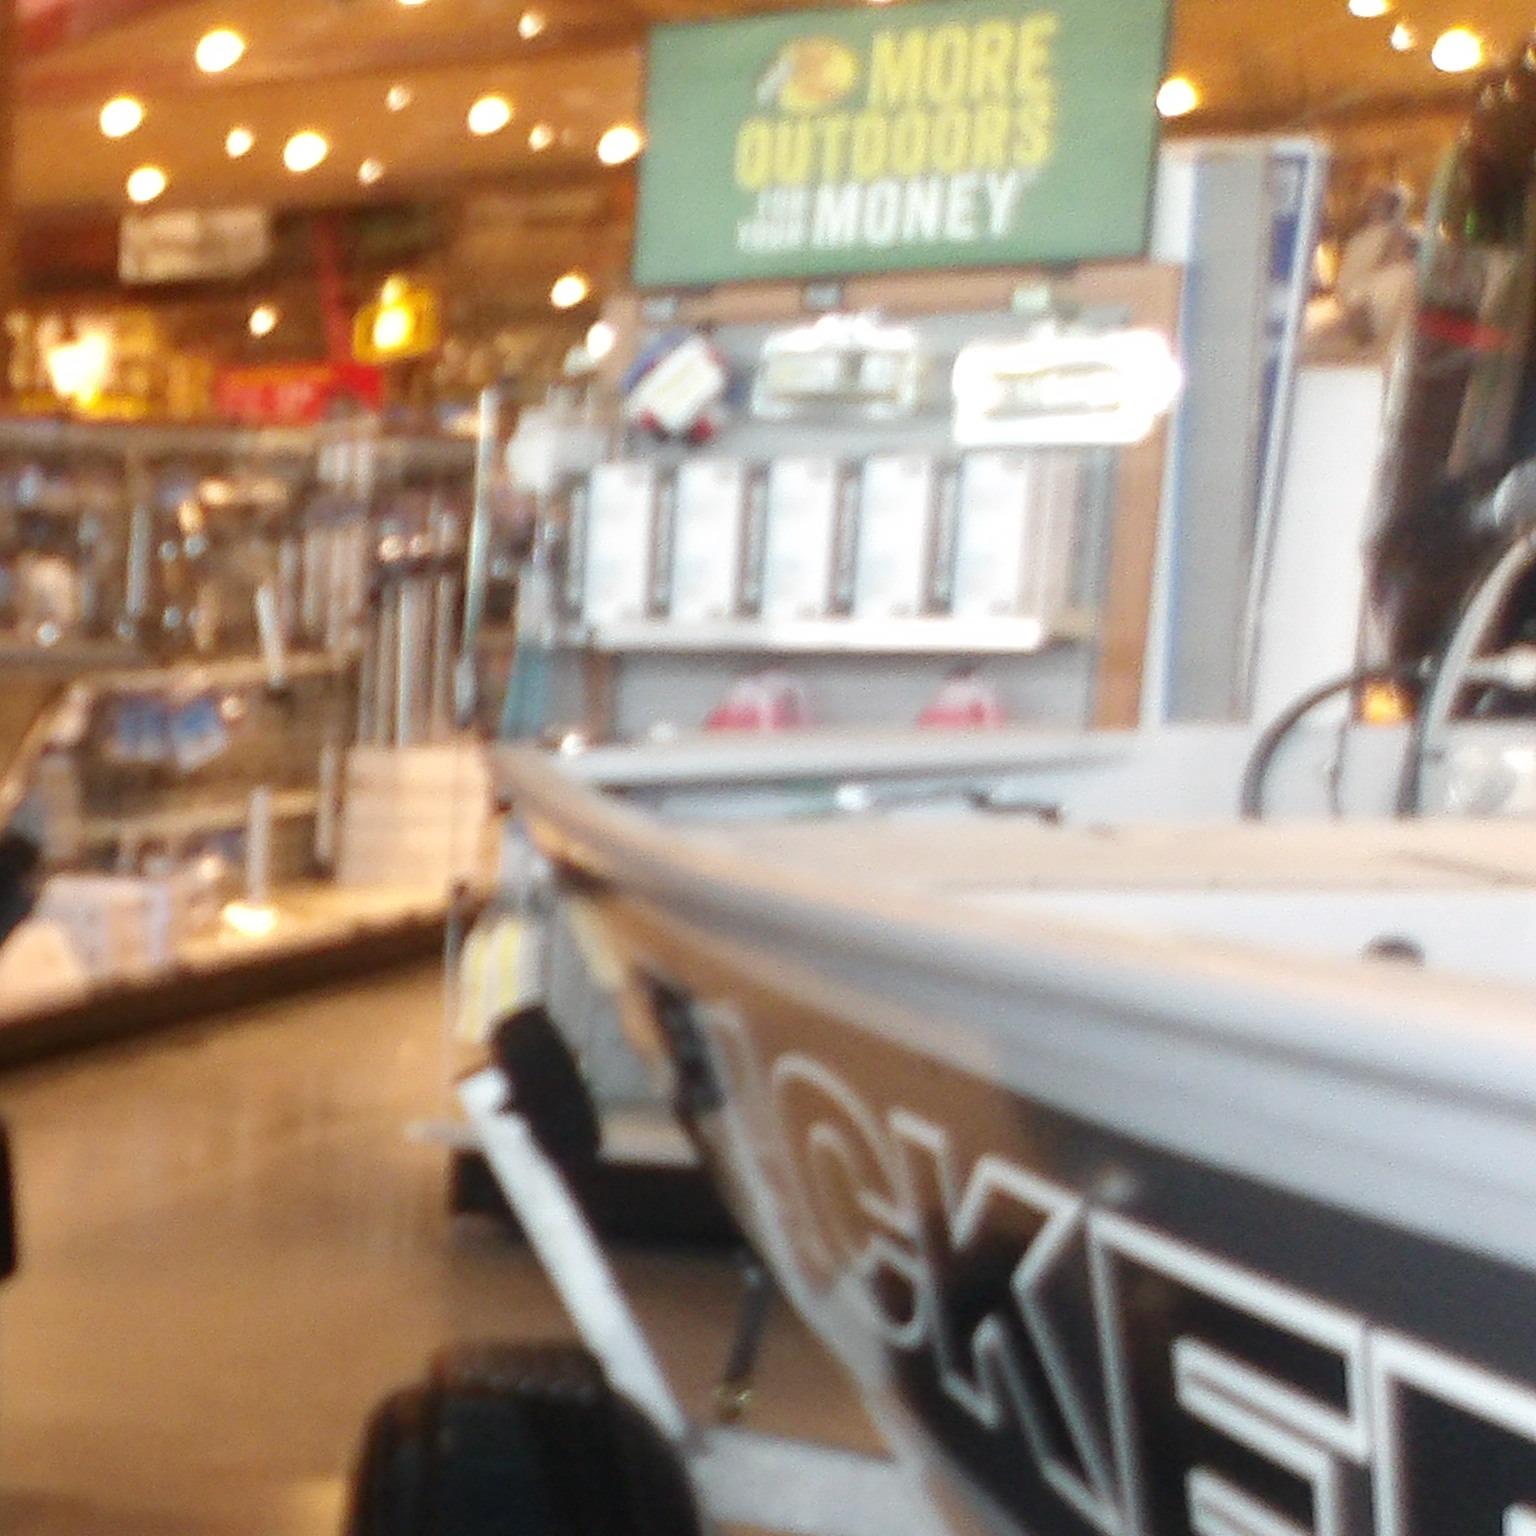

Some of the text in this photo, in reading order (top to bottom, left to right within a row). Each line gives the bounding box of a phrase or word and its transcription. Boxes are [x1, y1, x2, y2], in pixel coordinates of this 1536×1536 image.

[868, 12, 1058, 104] MORE
[736, 106, 1054, 191] OUTDOORS
[813, 172, 1020, 248] MONEY
